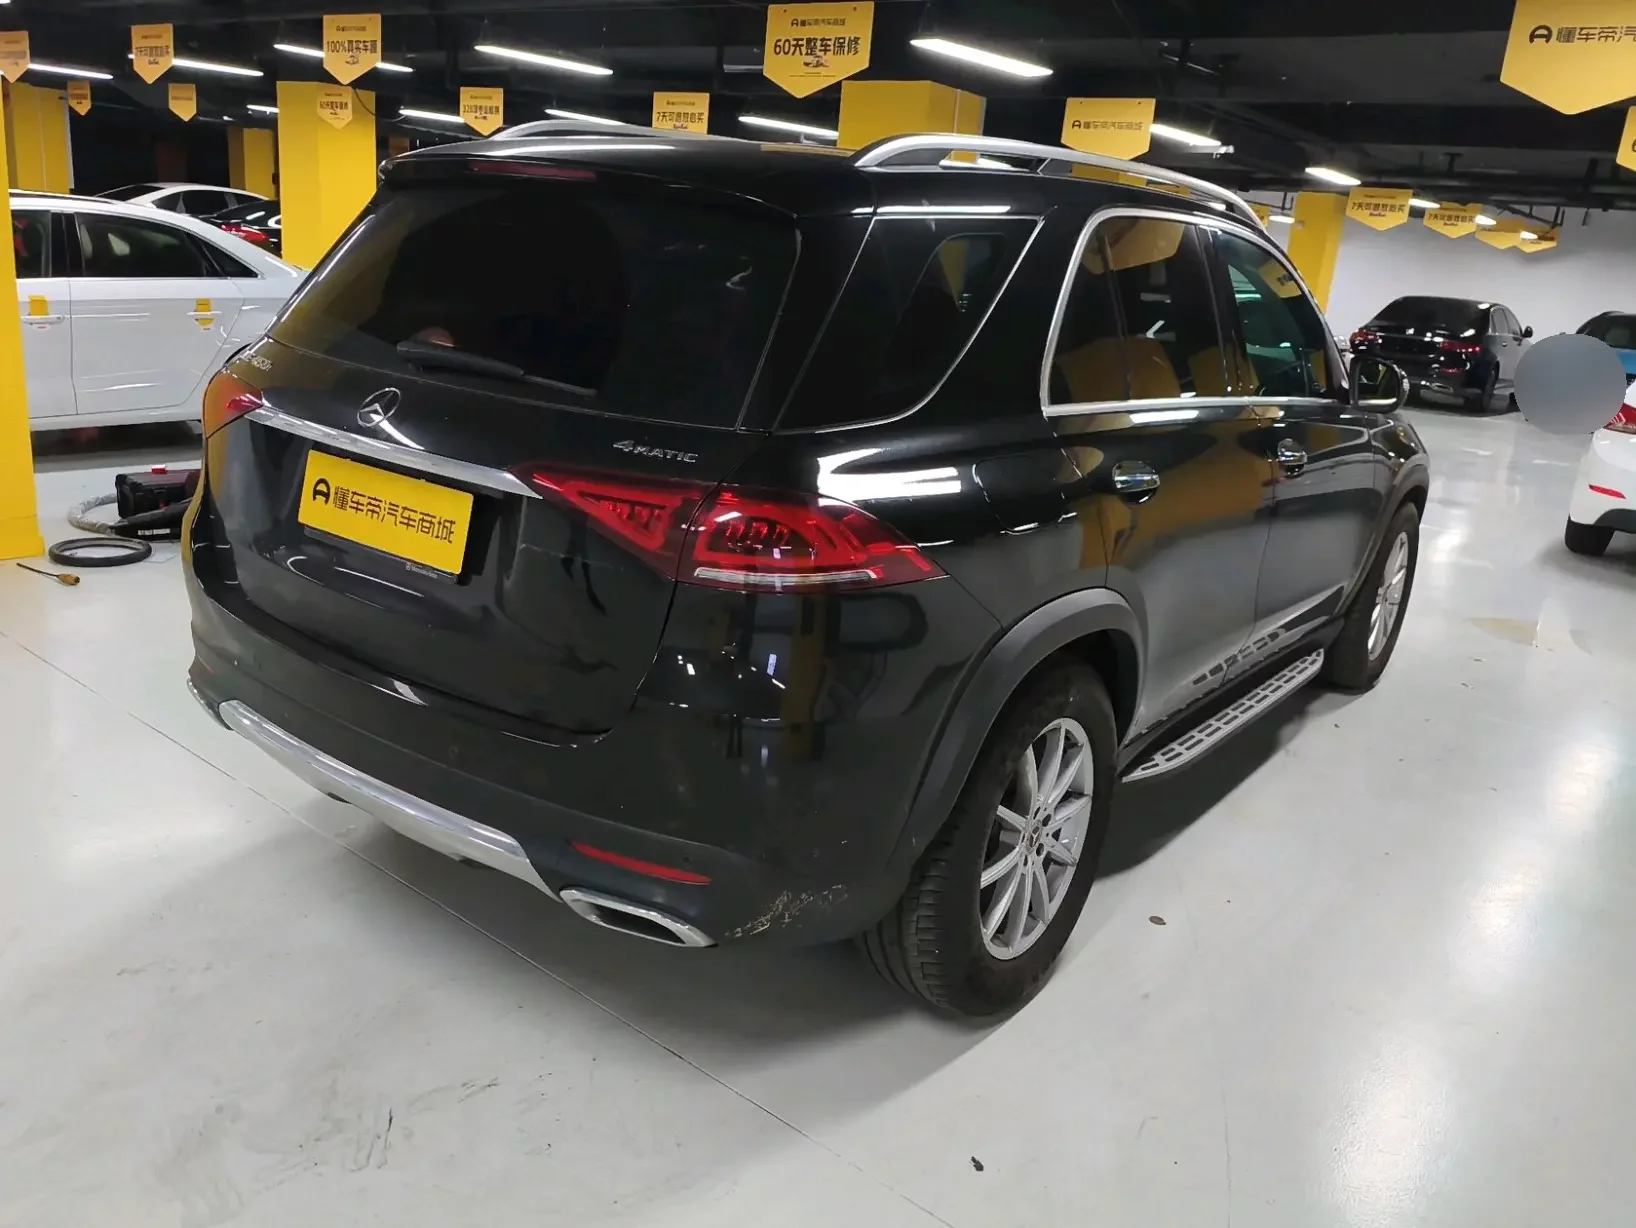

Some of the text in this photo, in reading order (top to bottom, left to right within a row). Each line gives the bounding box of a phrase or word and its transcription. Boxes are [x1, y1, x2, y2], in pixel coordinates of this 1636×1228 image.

[773, 36, 861, 56] 60天整车保修
[613, 439, 699, 463] 4MATIC
[333, 485, 457, 544] 懂车帝汽车商城
